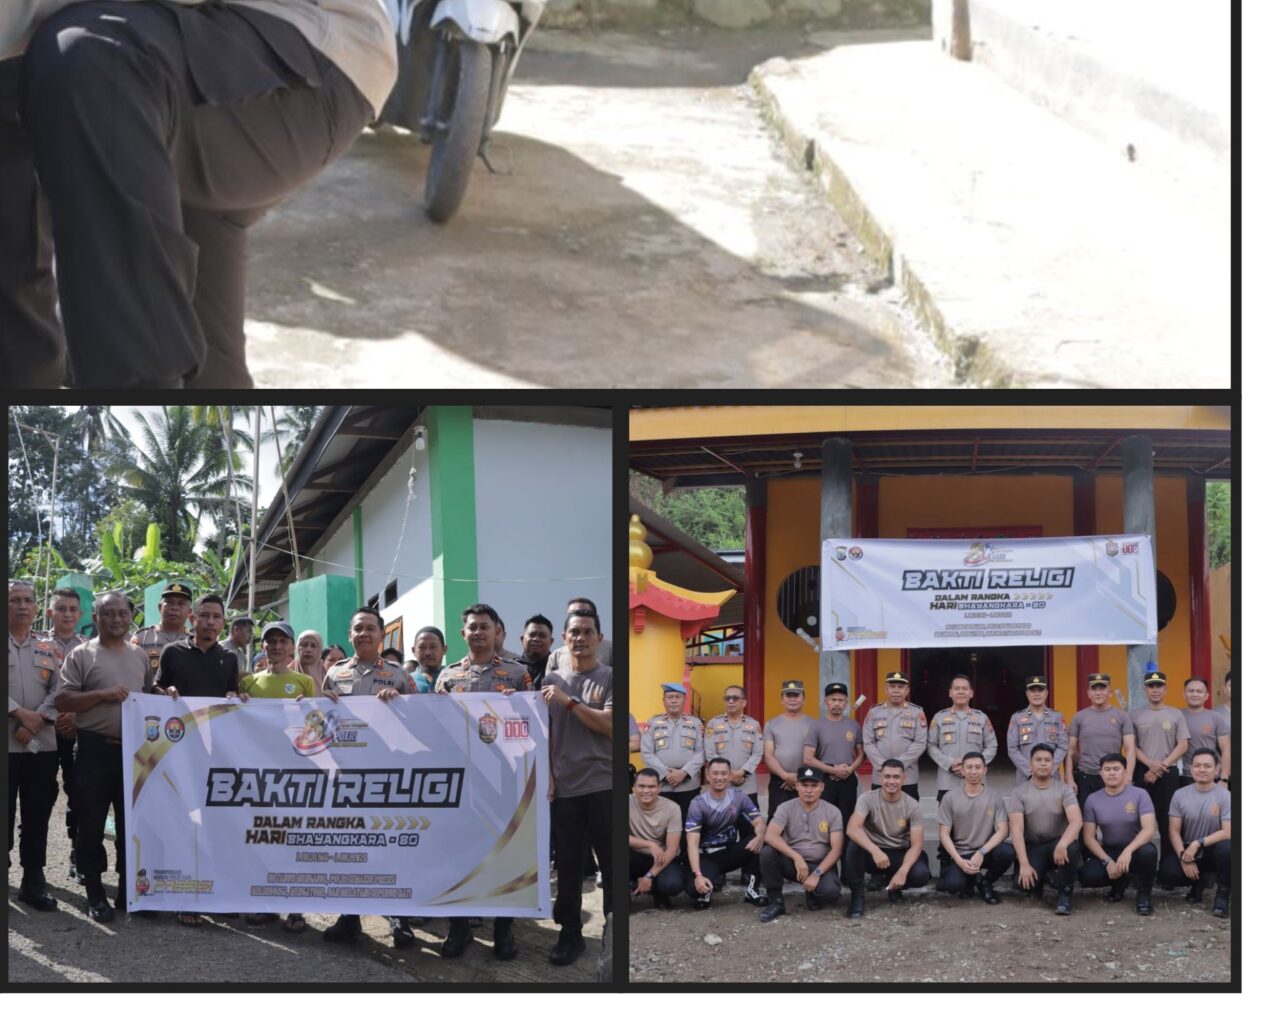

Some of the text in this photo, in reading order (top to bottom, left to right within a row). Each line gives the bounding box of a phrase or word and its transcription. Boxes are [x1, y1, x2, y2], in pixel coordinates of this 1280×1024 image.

[902, 567, 1075, 591] BAKTI RELIGI
[971, 593, 1010, 601] RANGKA
[930, 601, 957, 610] HARI
[505, 721, 529, 737] 110
[206, 768, 465, 808] BAKTI RELIGI
[253, 816, 366, 829] DALAM RANGKA
[245, 830, 286, 845] HARI
[286, 832, 387, 846] BHAYANGKARA
[398, 832, 420, 846] 80
[155, 879, 214, 891] PRESISI
